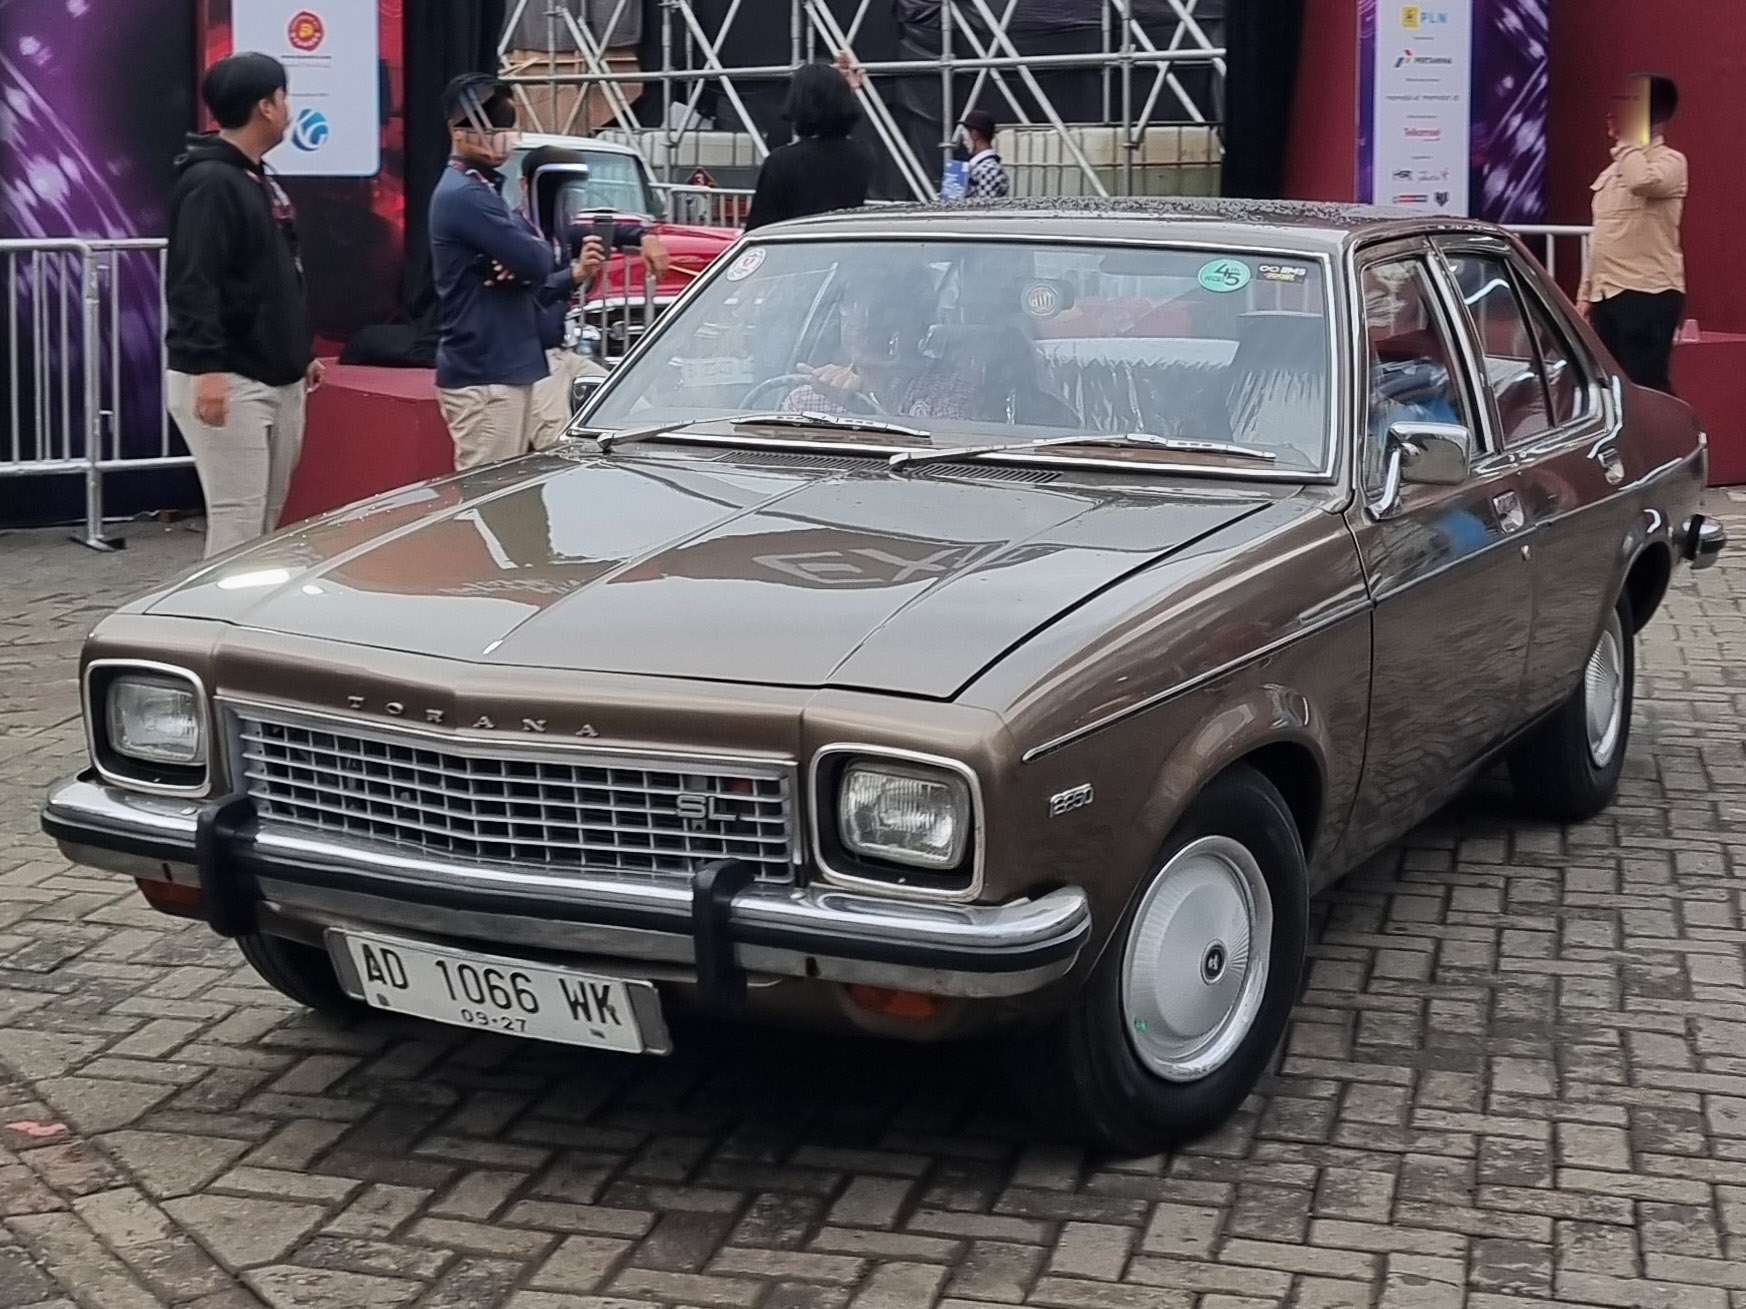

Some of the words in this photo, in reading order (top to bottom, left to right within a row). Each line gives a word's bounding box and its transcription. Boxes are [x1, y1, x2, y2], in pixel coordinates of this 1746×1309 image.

[1420, 11, 1448, 24] PLN
[347, 695, 600, 738] TORANA
[676, 794, 738, 822] SL
[360, 943, 410, 990] AD
[435, 959, 540, 1015] 1066
[558, 976, 622, 1027] WK
